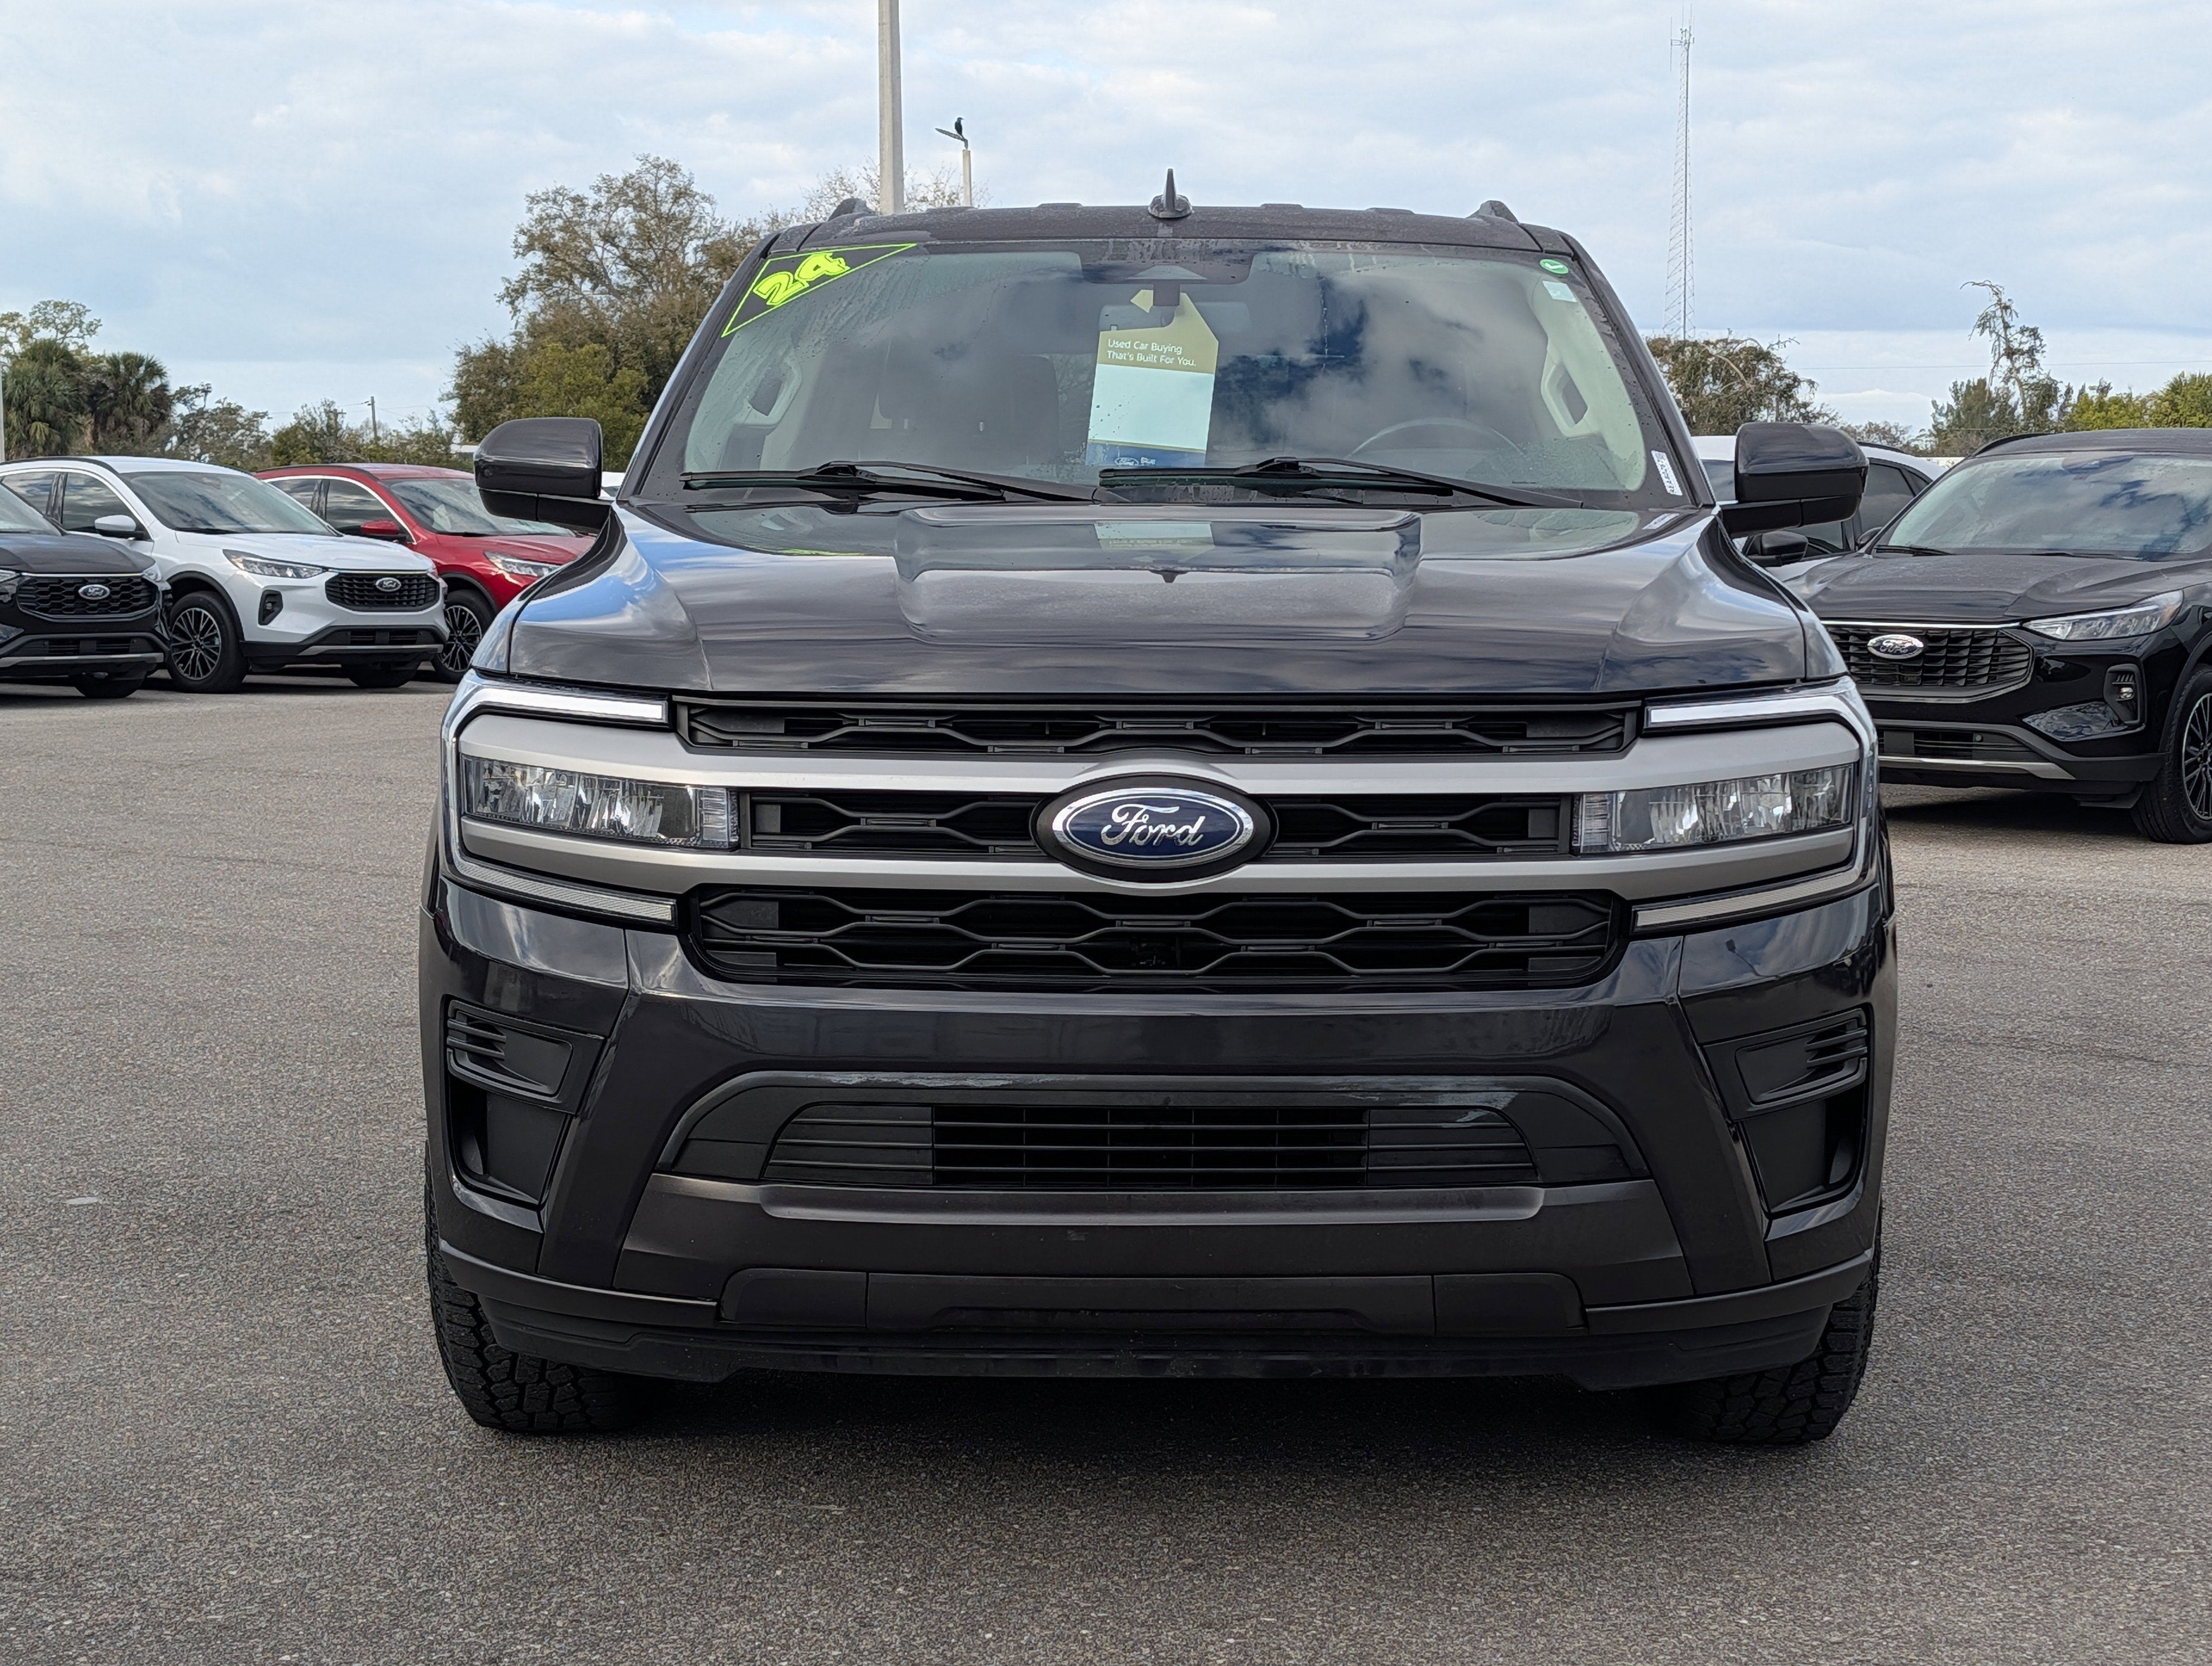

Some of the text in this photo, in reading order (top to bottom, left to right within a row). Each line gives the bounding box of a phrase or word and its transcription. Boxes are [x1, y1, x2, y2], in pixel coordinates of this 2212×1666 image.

[753, 253, 850, 305] 24
[1107, 350, 1197, 366] That's Built For You.
[1108, 339, 1182, 355] Used Car Buying
[1101, 803, 1205, 846] Ford
